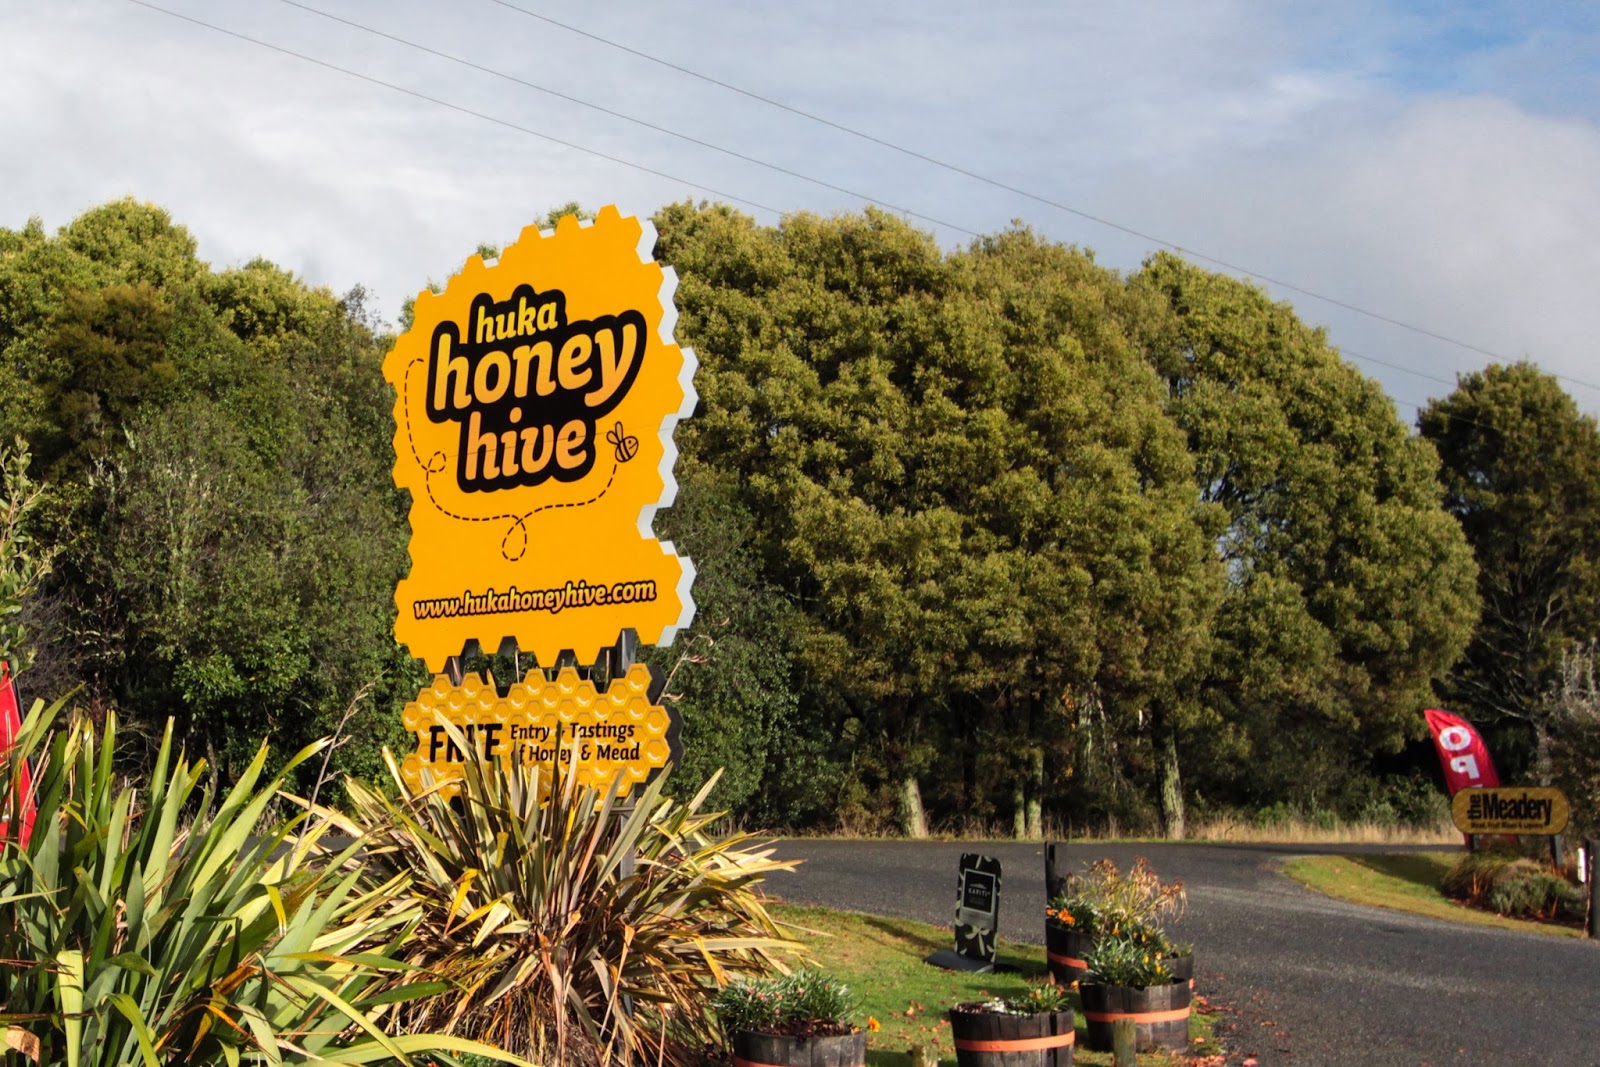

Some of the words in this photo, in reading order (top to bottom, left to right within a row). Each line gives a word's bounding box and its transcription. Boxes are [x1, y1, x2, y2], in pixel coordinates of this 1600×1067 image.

[475, 296, 559, 344] huka
[433, 322, 638, 412] honey
[464, 406, 588, 481] hive
[414, 580, 656, 619] www.hukahoneyhive.com
[510, 724, 550, 743] Entry
[570, 720, 635, 743] Tastings
[581, 744, 592, 761] &
[597, 742, 641, 761] Mead
[1467, 794, 1482, 820] the
[1482, 793, 1553, 826] Meadery
